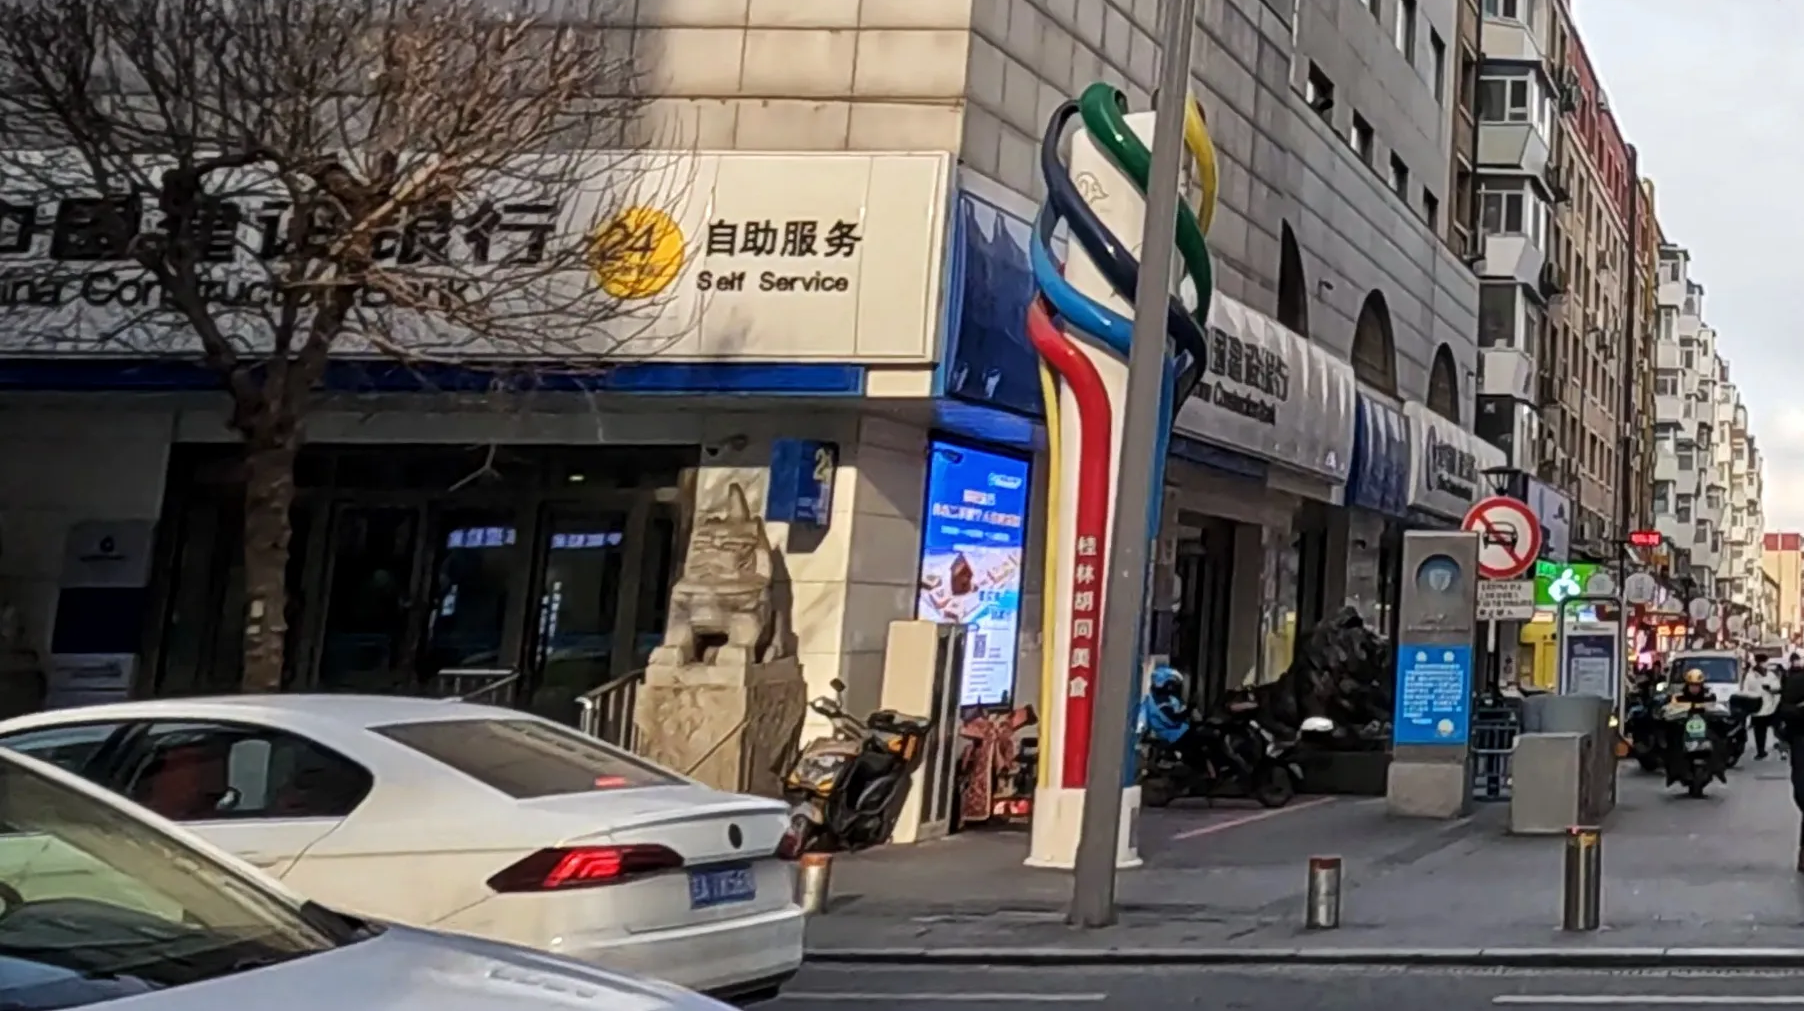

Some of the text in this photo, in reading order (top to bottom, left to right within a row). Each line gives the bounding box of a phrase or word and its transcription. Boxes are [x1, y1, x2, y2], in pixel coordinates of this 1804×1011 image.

[706, 219, 862, 257] 自助服务
[696, 270, 849, 293] Self Service
